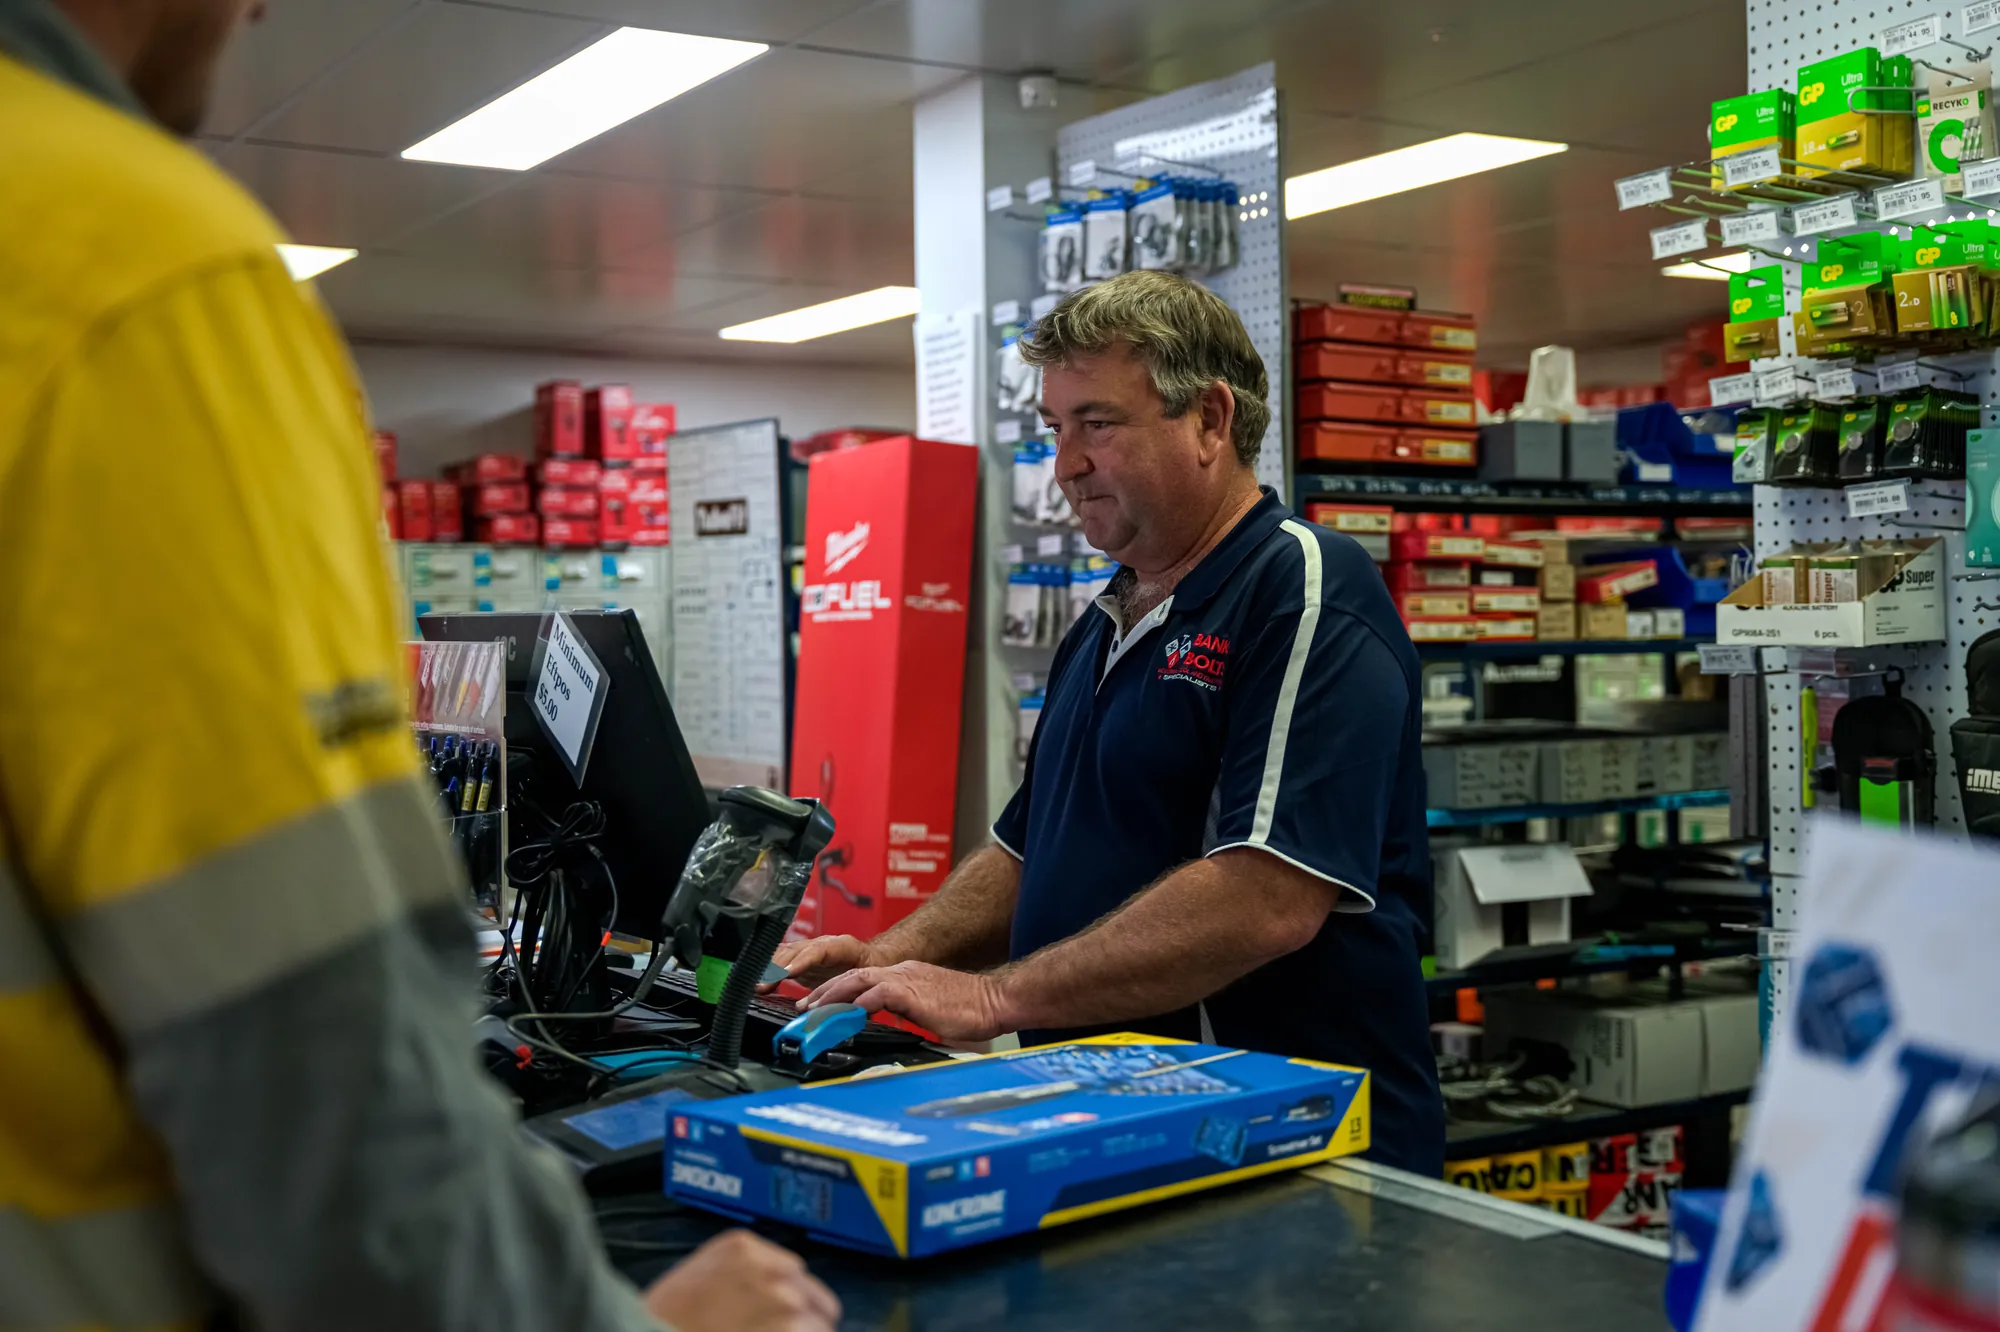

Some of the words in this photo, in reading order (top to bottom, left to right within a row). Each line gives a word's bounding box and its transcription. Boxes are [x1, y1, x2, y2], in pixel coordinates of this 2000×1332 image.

[1841, 73, 1863, 86] Ultra
[1799, 82, 1824, 106] GP
[1715, 114, 1738, 132] GP
[1915, 247, 1941, 265] GP
[1962, 243, 1985, 254] Ultra
[1821, 264, 1844, 282] GP
[1732, 297, 1753, 315] GP
[1906, 569, 1935, 587] Super
[553, 623, 594, 693] Minimum
[545, 652, 571, 701] Eftpos
[538, 683, 558, 722] $5.00
